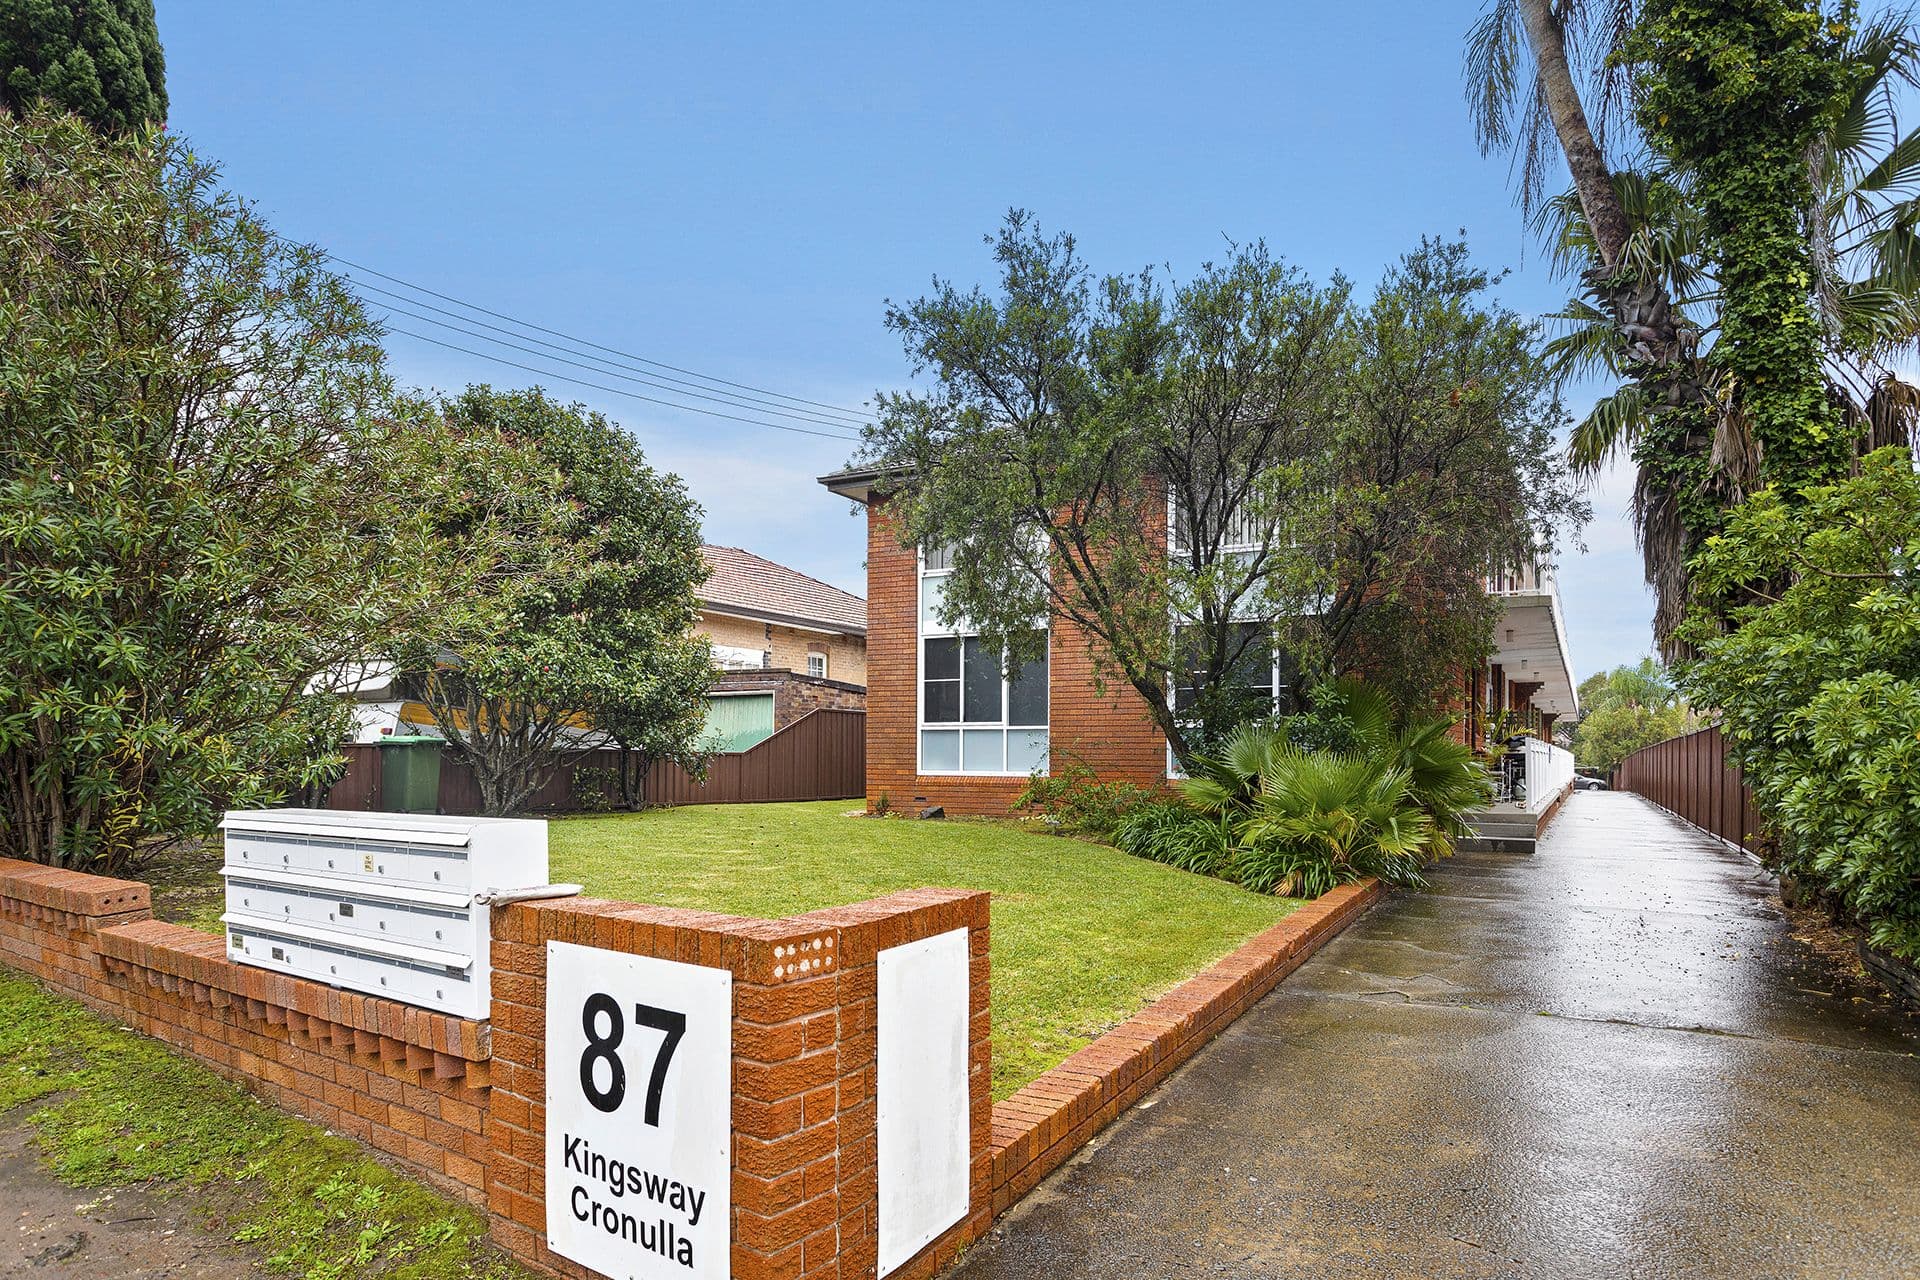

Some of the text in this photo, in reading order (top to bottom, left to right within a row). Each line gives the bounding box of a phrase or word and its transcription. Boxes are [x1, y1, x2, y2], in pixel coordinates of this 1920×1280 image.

[580, 992, 686, 1128] 87
[564, 1133, 706, 1227] Kingsway
[571, 1185, 694, 1269] Cronulla
